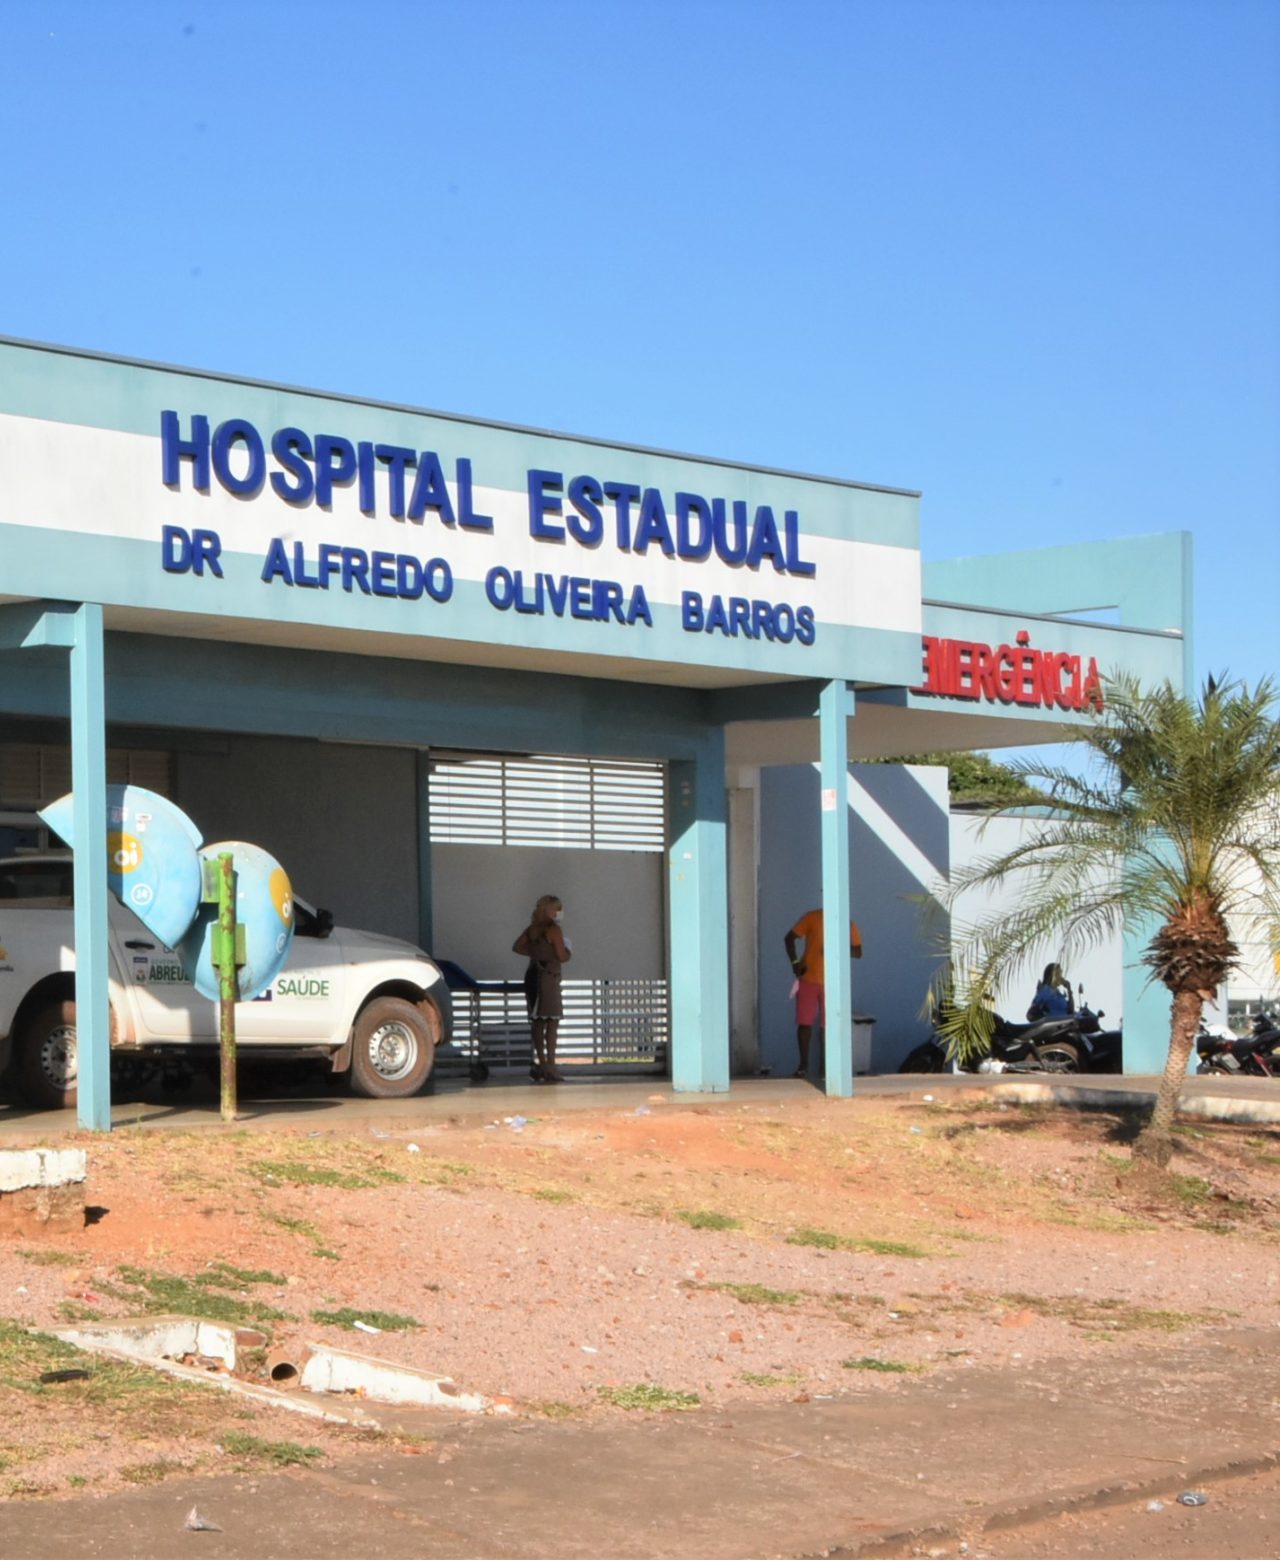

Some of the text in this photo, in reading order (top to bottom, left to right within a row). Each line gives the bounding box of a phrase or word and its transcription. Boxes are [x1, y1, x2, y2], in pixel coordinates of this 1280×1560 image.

[161, 410, 816, 577] HOSPITAL ESTADUAL
[162, 524, 816, 646] DR ALFREDO OLIVEIRA BARROS
